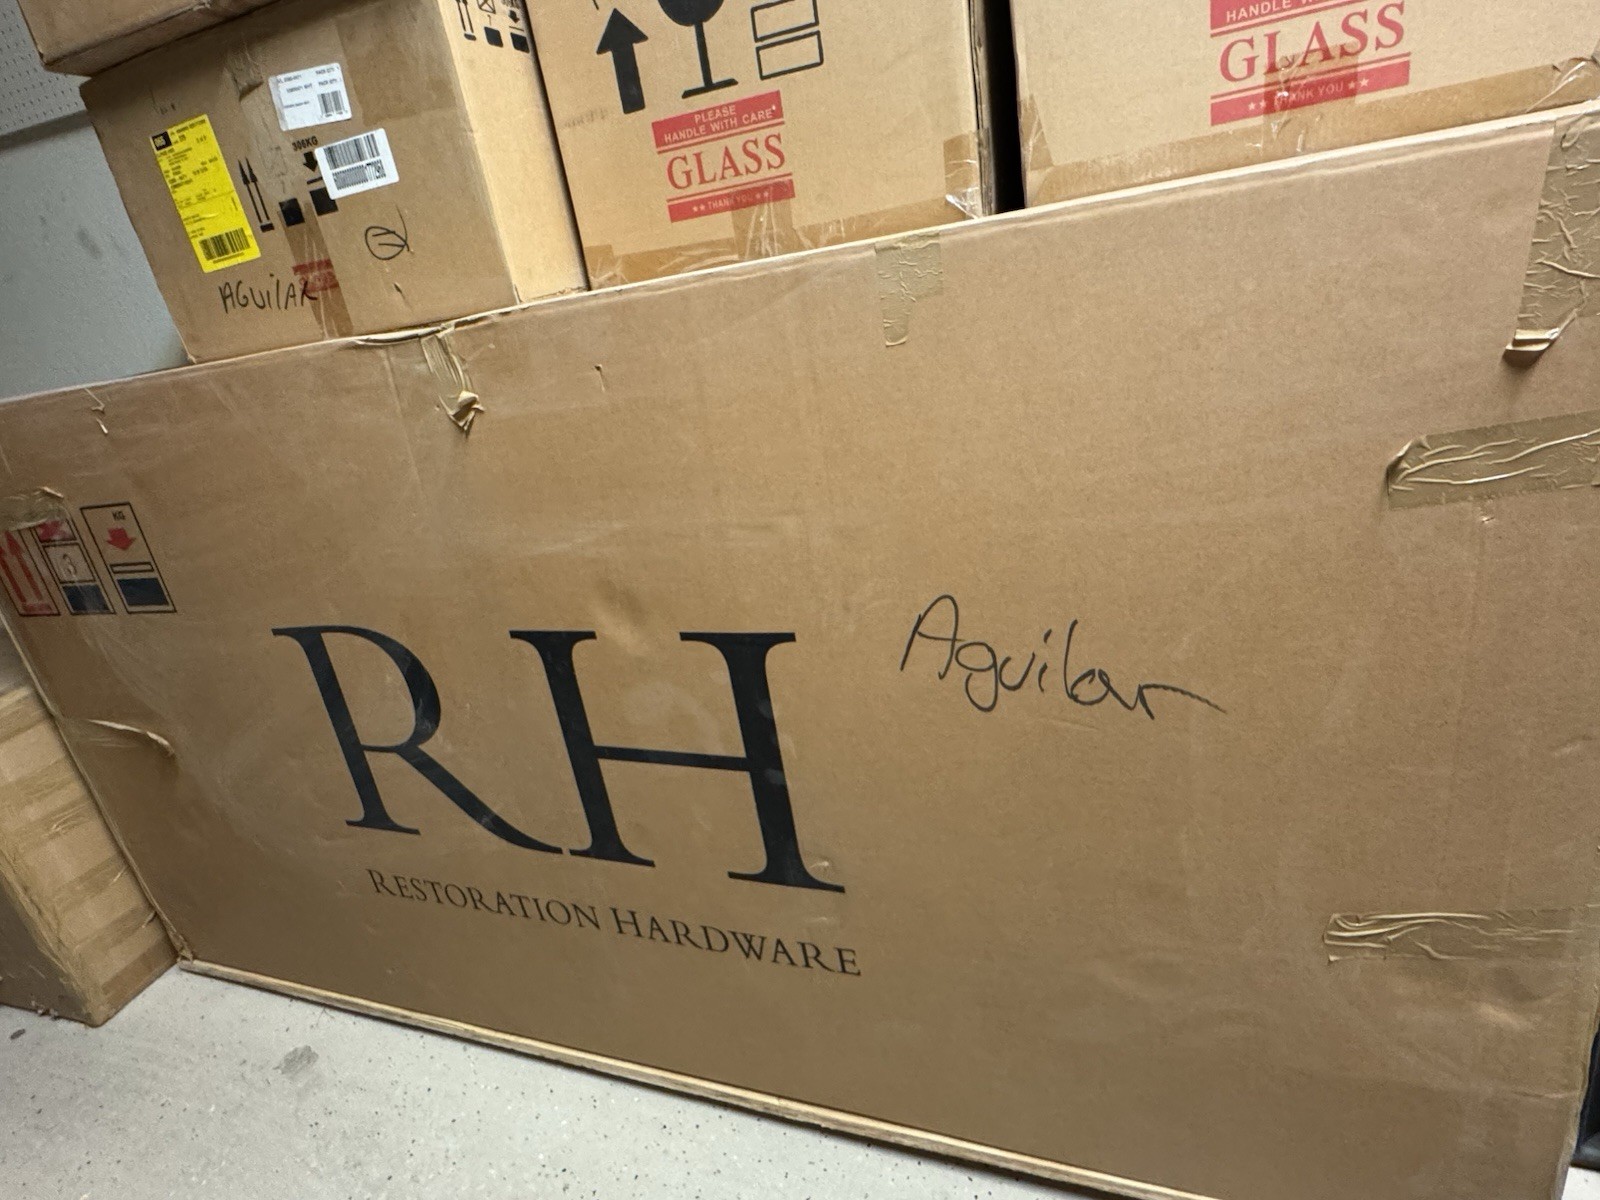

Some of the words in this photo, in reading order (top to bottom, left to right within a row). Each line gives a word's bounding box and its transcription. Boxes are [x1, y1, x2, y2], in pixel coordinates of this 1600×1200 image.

[1219, 1, 1406, 83] GLASS
[694, 104, 737, 125] PLEASE
[1318, 80, 1344, 97] YOU
[663, 124, 707, 144] HANDLE
[709, 116, 738, 133] WITH
[741, 109, 773, 125] CARE
[666, 131, 786, 190] GLASS
[707, 196, 735, 212] THANK
[900, 594, 1228, 720] Aguilar
[271, 625, 846, 894] RH
[366, 867, 601, 930] RESTORATION
[607, 906, 863, 977] HARDWARE
